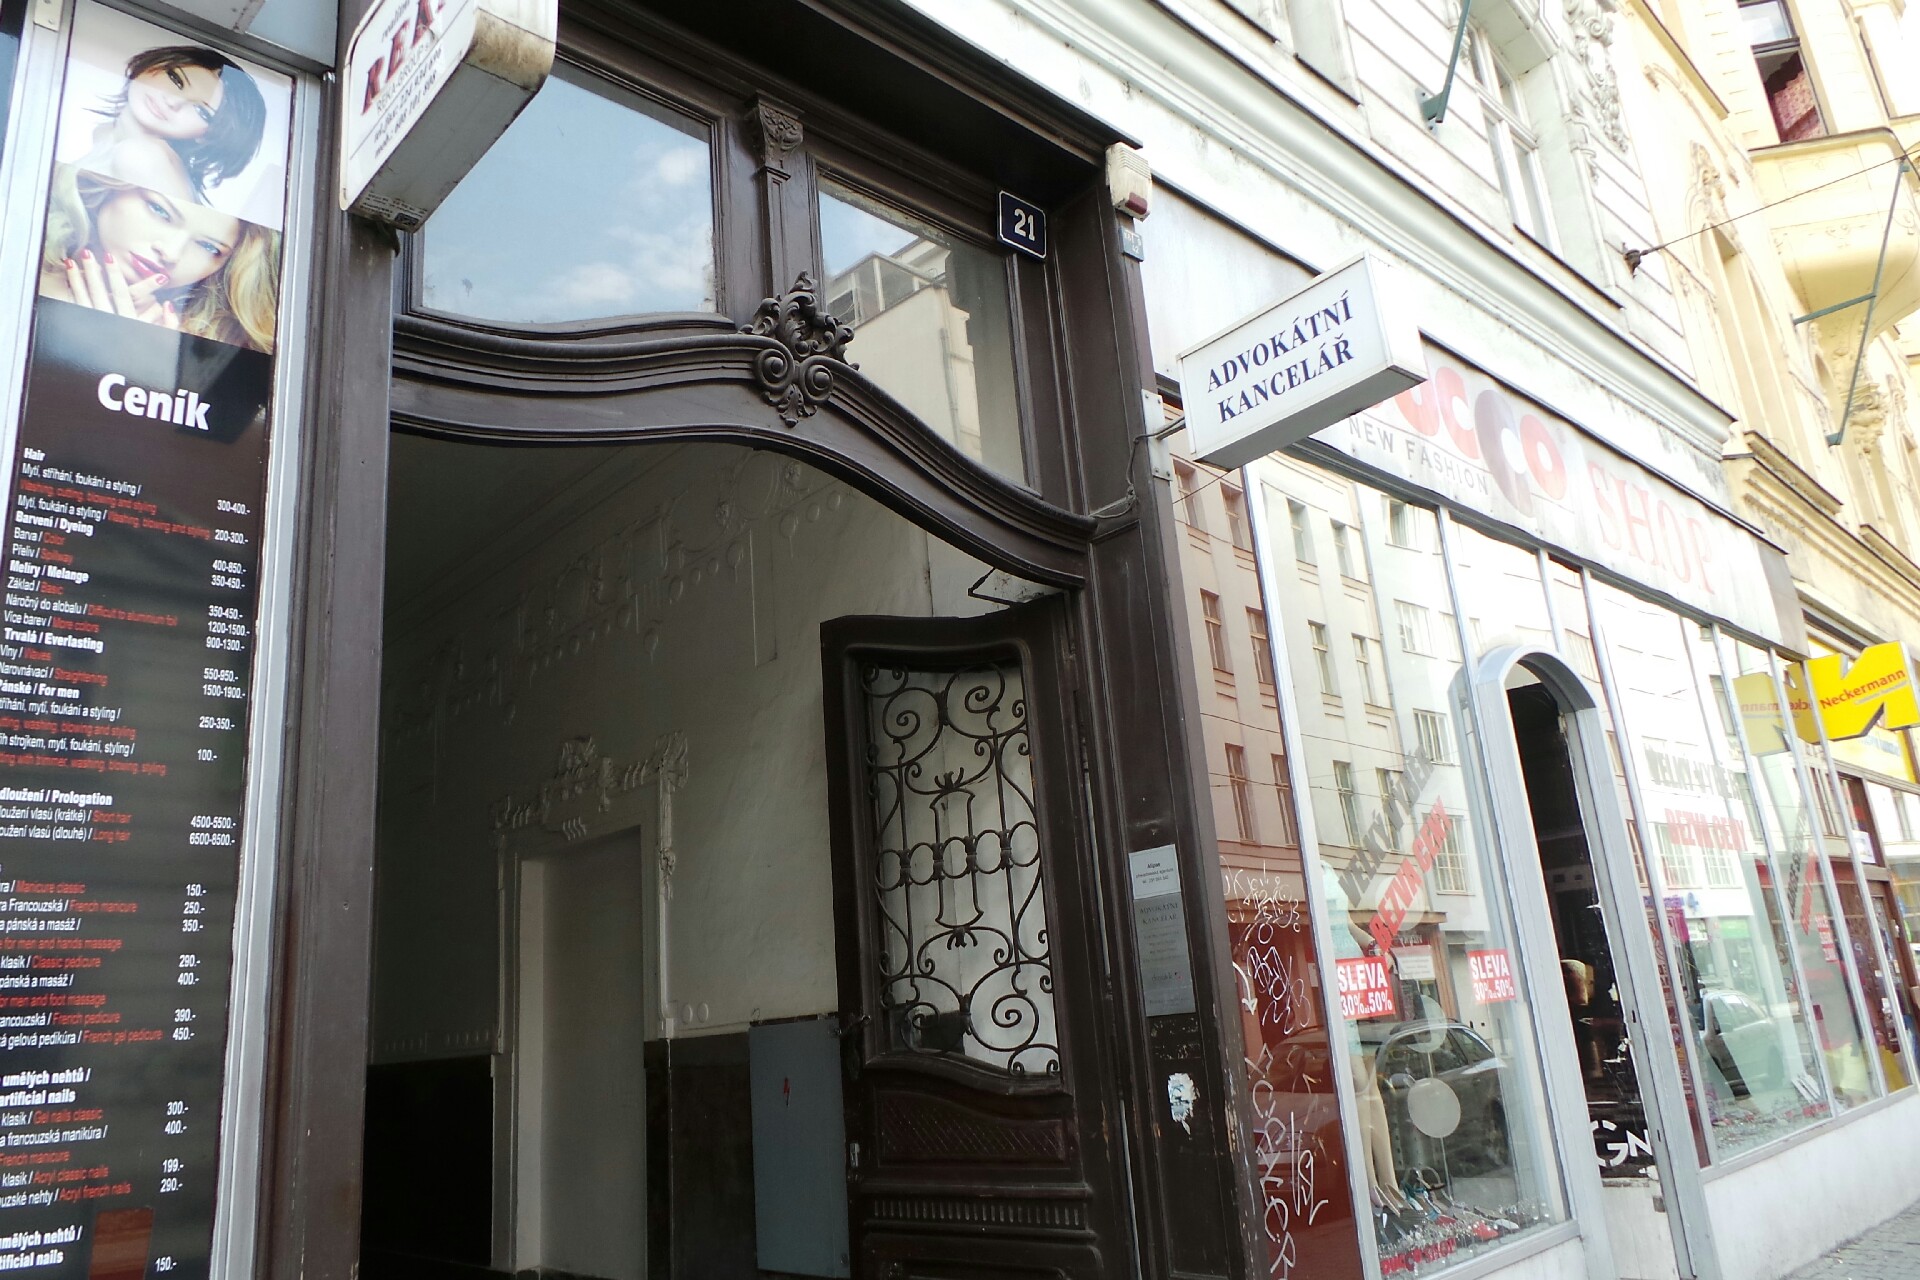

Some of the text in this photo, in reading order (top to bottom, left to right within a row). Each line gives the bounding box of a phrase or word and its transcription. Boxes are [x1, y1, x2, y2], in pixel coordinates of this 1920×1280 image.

[1014, 208, 1036, 242] 21
[1207, 289, 1354, 393] ADVOKÁTNÍ
[1219, 333, 1355, 424] KANCELÁŘ
[98, 373, 211, 431] Ceník
[24, 447, 46, 461] Hair
[1349, 416, 1489, 496] NEW FASHION
[105, 480, 112, 489] a
[112, 481, 137, 497] styling
[217, 500, 250, 515] 300-400.-
[14, 527, 38, 542] Barva
[16, 511, 94, 537] Barvení Dyeing
[69, 505, 75, 515] a
[76, 506, 102, 522] styling
[214, 529, 249, 545] 200-300.-
[1587, 459, 1715, 595] SHOP
[12, 543, 246, 590] Přeliv 350-450.-
[47, 565, 90, 584] Melange
[7, 576, 36, 591] Základ
[208, 605, 244, 620] 350-450.-
[5, 592, 39, 611] Náročný
[40, 598, 52, 611] do
[52, 600, 82, 615] alobalu
[208, 621, 250, 637] 1200-1500.-
[4, 609, 23, 624] Více
[23, 612, 48, 626] barev
[206, 636, 245, 651] 900-1300.-
[4, 627, 104, 654] Trvalá Everlasting
[203, 667, 239, 682] 550-950.-
[38, 683, 80, 699] For men
[202, 684, 246, 699] 1500-1900.-
[1819, 669, 1907, 710] Neckermann
[82, 707, 89, 717] a
[90, 706, 116, 722] styling
[199, 716, 235, 731] 250-350.-
[104, 742, 131, 758] styling
[197, 749, 218, 761] 100.-
[51, 790, 113, 807] Prologation
[54, 808, 87, 824] (krátké)
[190, 815, 237, 829] 4500-5500.-
[1664, 807, 1749, 852] BEZVA CENY
[52, 826, 87, 842] (dlouhé)
[189, 833, 236, 846] 6500-8500.-
[1338, 808, 1391, 908] VELKÝ
[1368, 857, 1423, 952] BEZVA
[1412, 795, 1453, 875] CENY
[186, 884, 207, 897] 150.-
[9, 898, 63, 912] Francouzská
[183, 902, 205, 914] 250.-
[6, 918, 204, 933] pánská a masáž 350.-
[0, 955, 26, 969] klasik
[178, 954, 201, 968] 290.-
[1470, 955, 1511, 980] SLEVA
[31, 978, 38, 987] a
[39, 974, 69, 987] masáž
[178, 972, 200, 986] 400.-
[1337, 962, 1388, 993] SLEVA
[174, 1008, 197, 1022] 390.-
[7, 1032, 38, 1051] gelová
[38, 1030, 77, 1048] pedikúra
[172, 1027, 195, 1041] 450.-
[2, 1067, 85, 1089] umělých nehtů
[47, 1088, 76, 1104] nails
[0, 1112, 27, 1127] klasik
[166, 1101, 189, 1116] 300.-
[7, 1128, 60, 1147] francouzská
[61, 1126, 102, 1142] manikúra
[164, 1120, 188, 1135] 400.-
[1, 1171, 28, 1187] klasik
[162, 1158, 185, 1173] 199.-
[28, 1189, 53, 1207] nehty
[160, 1177, 184, 1193] 290.-
[43, 1225, 76, 1245] nehtů
[35, 1249, 65, 1266] nails
[155, 1256, 178, 1273] 150.-
